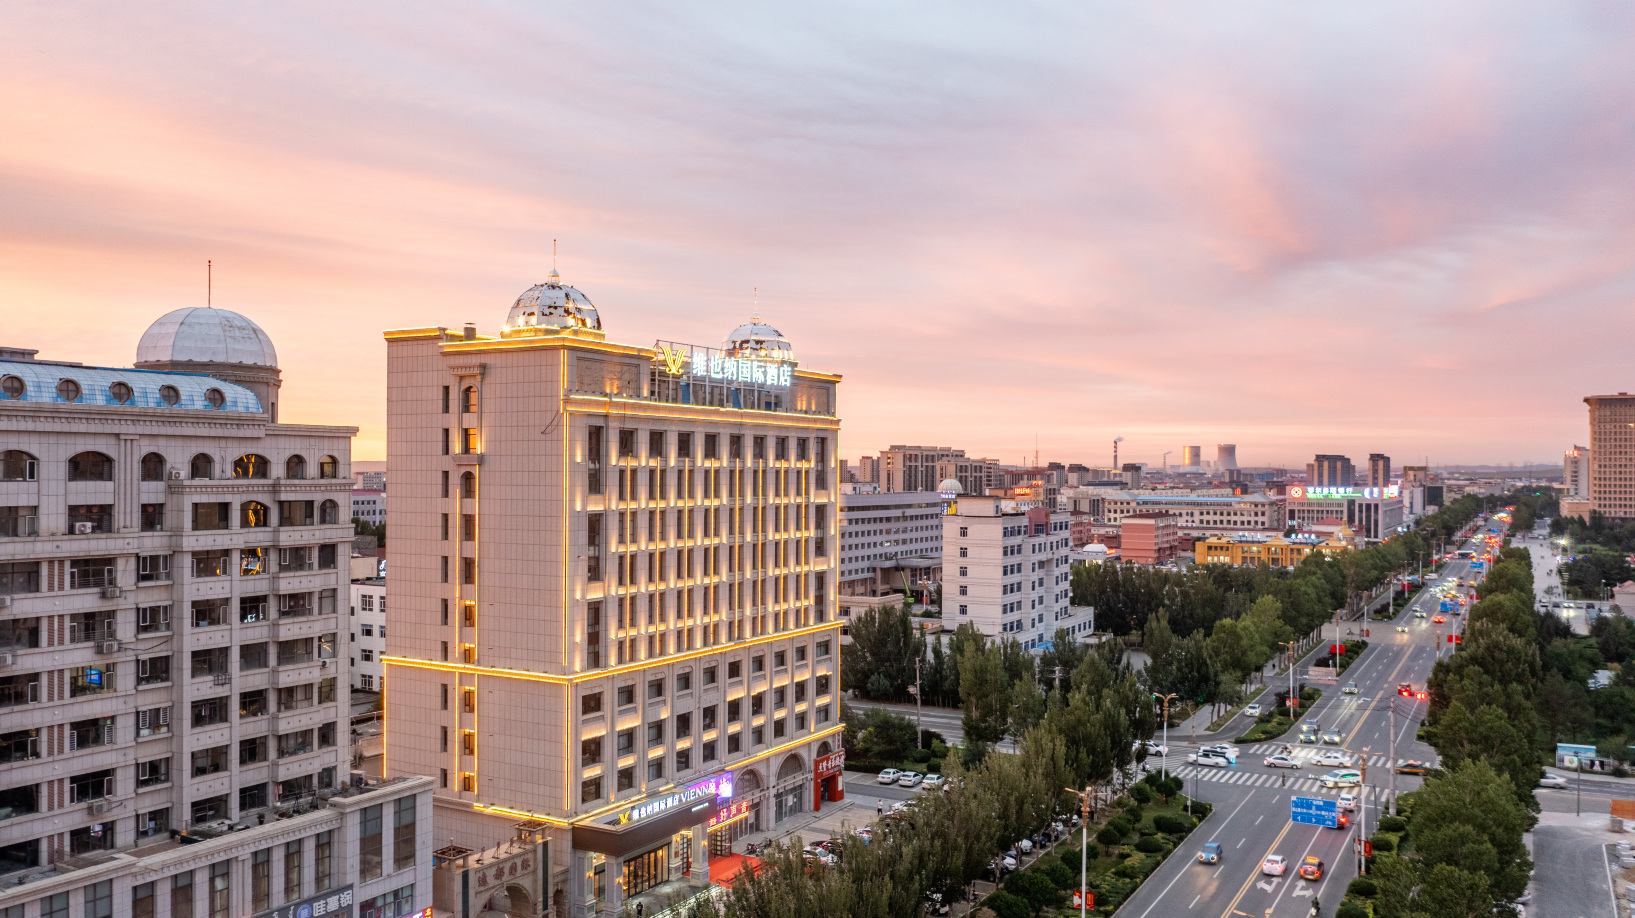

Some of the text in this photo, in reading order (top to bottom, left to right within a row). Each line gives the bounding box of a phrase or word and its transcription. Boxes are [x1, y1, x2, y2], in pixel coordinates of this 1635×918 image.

[692, 352, 792, 386] 维也纳国际酒店
[632, 794, 680, 821] 维也纳国际酒店
[680, 783, 716, 803] VIENNA
